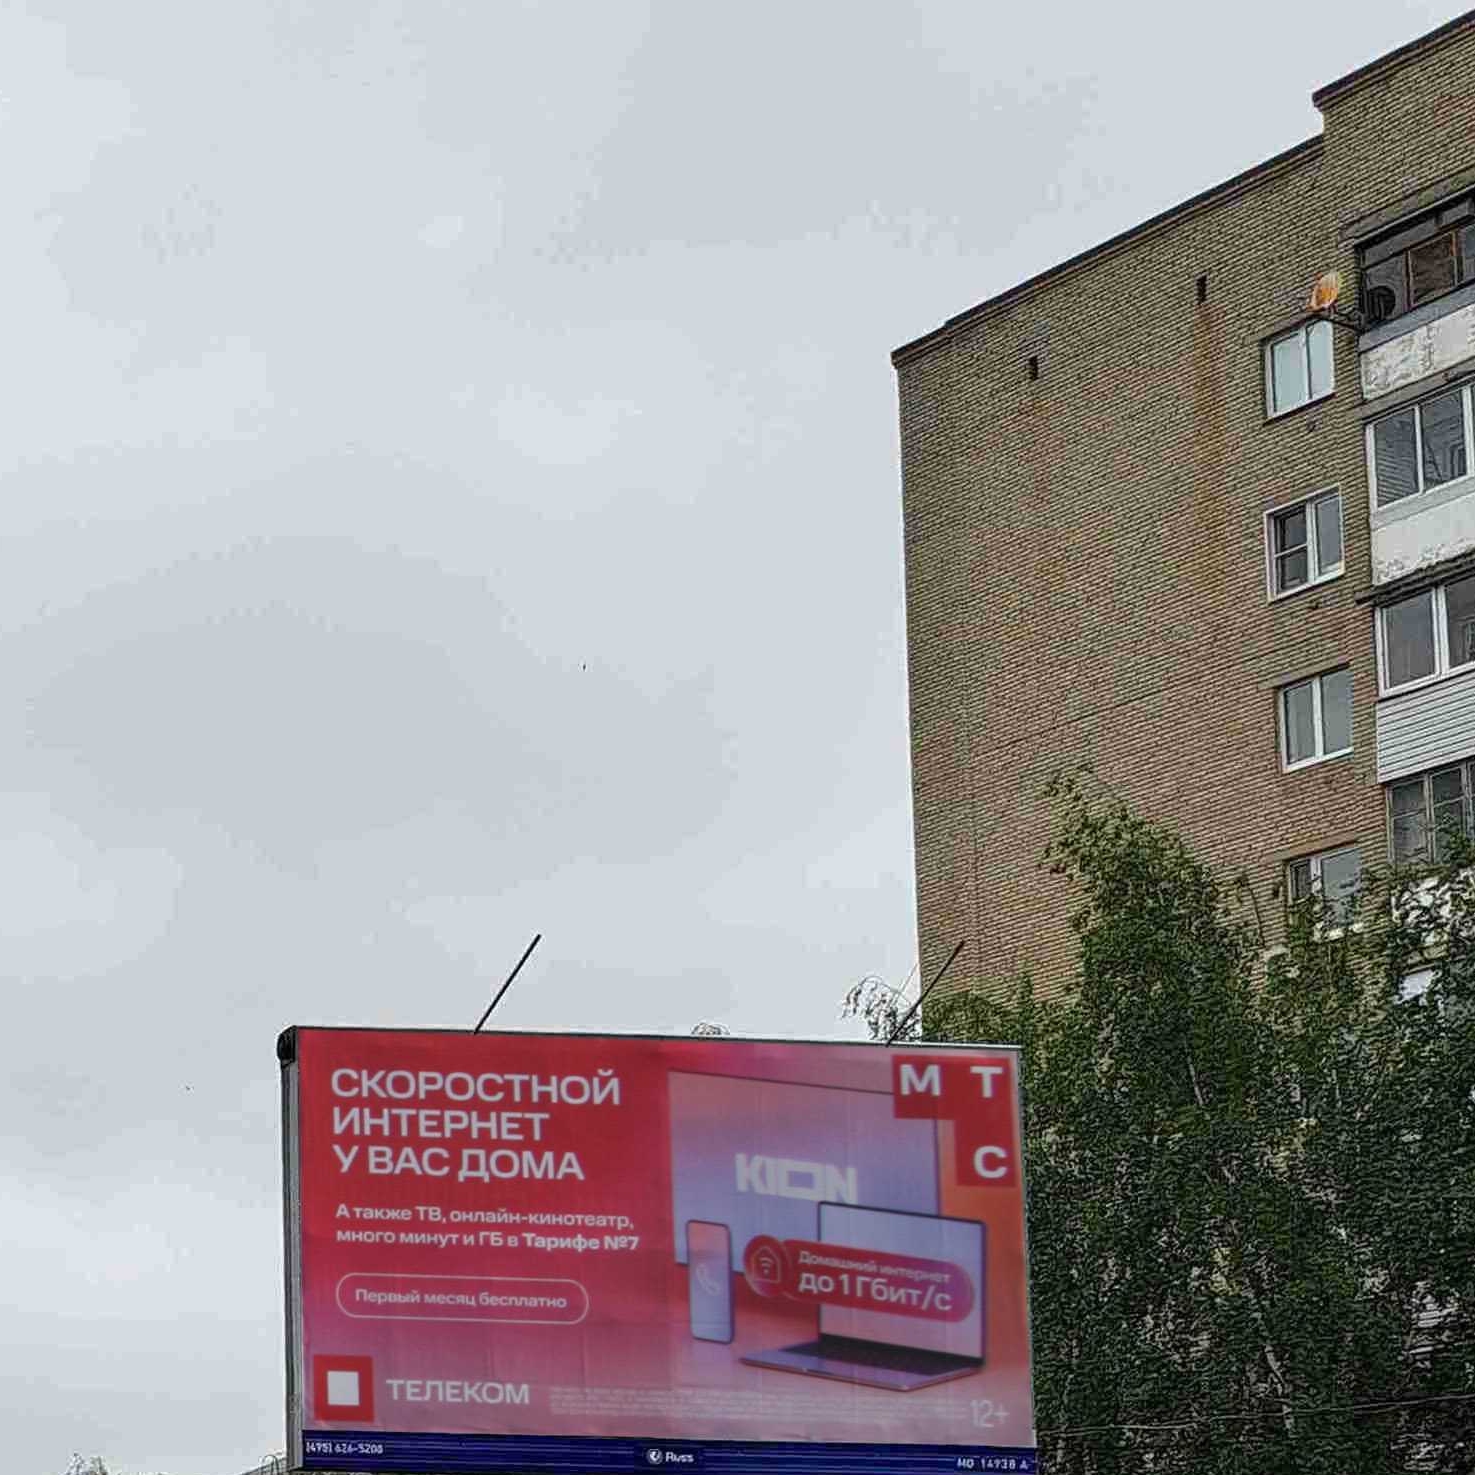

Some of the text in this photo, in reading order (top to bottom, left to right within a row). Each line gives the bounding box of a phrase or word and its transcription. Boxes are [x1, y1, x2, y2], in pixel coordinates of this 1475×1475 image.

[331, 1068, 621, 1105] СКОРОСТНОЙ
[332, 1106, 551, 1141] ИНТЕРНЕТ
[332, 1144, 586, 1182] У ВАС ДОМА
[734, 1153, 858, 1204] KION
[335, 1204, 635, 1230] А также ТВ, онлайн-кинотеатр,
[336, 1230, 640, 1251] много минут и ГБ в Тарифе №7
[798, 1251, 951, 1283] Домашний интернет
[355, 1288, 568, 1308] Первый месяц бесплатно
[798, 1273, 953, 1311] до 1 Гбит/с
[385, 1379, 530, 1404] ТЕЛЕКОМ
[971, 1400, 1010, 1428] 12+
